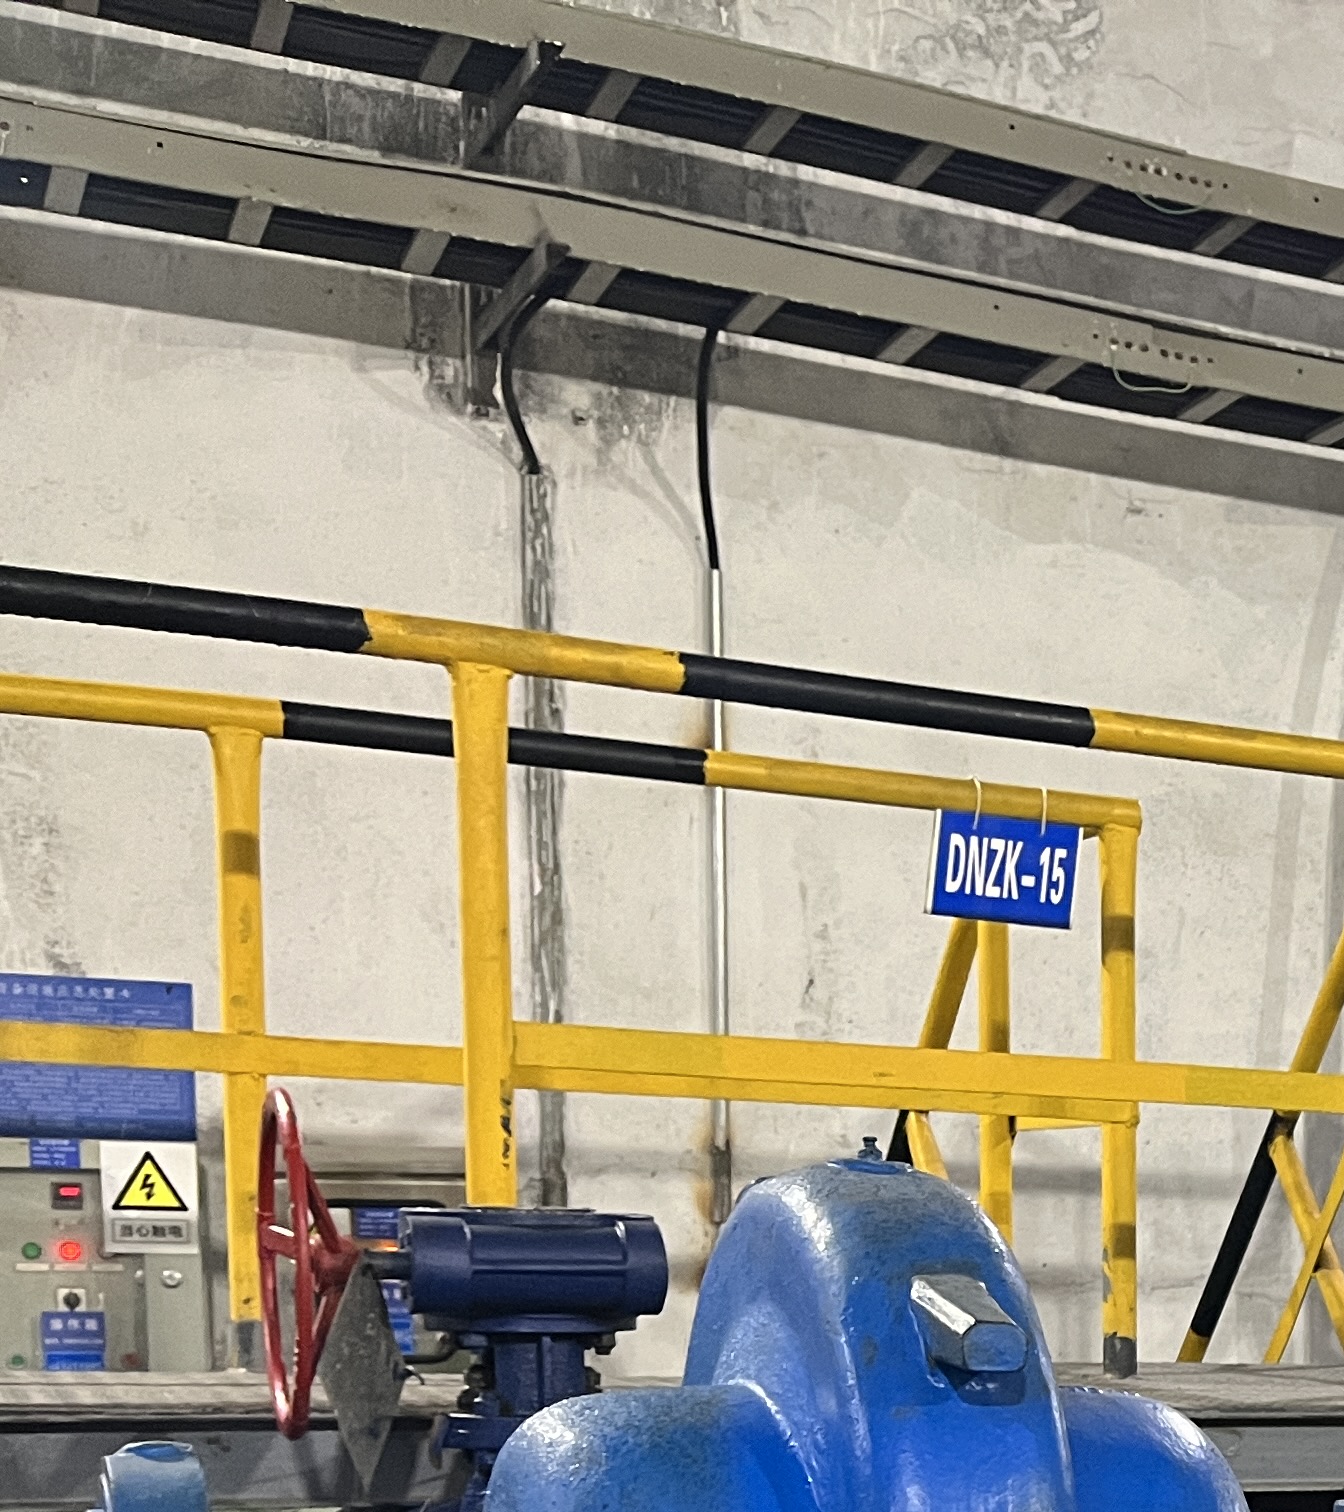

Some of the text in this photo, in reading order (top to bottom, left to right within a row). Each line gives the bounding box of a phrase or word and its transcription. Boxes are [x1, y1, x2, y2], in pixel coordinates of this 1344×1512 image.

[944, 833, 1068, 905] DNZK-15
[119, 1223, 184, 1239] 当心触电
